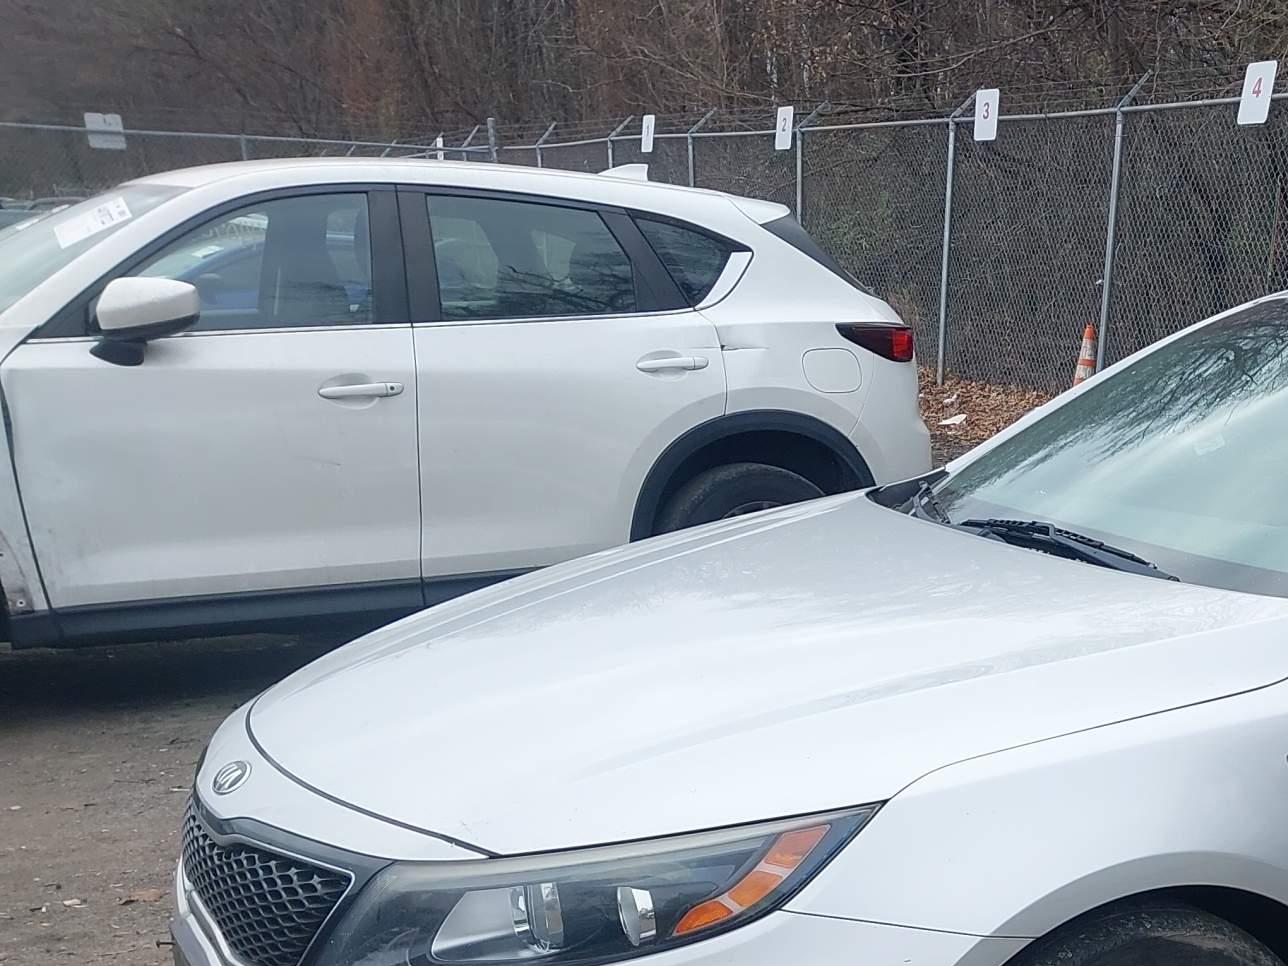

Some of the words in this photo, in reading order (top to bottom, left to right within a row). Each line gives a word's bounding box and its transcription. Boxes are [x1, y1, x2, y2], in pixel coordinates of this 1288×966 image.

[1252, 77, 1263, 98] 4
[982, 102, 990, 119] 3
[781, 117, 787, 132] 2
